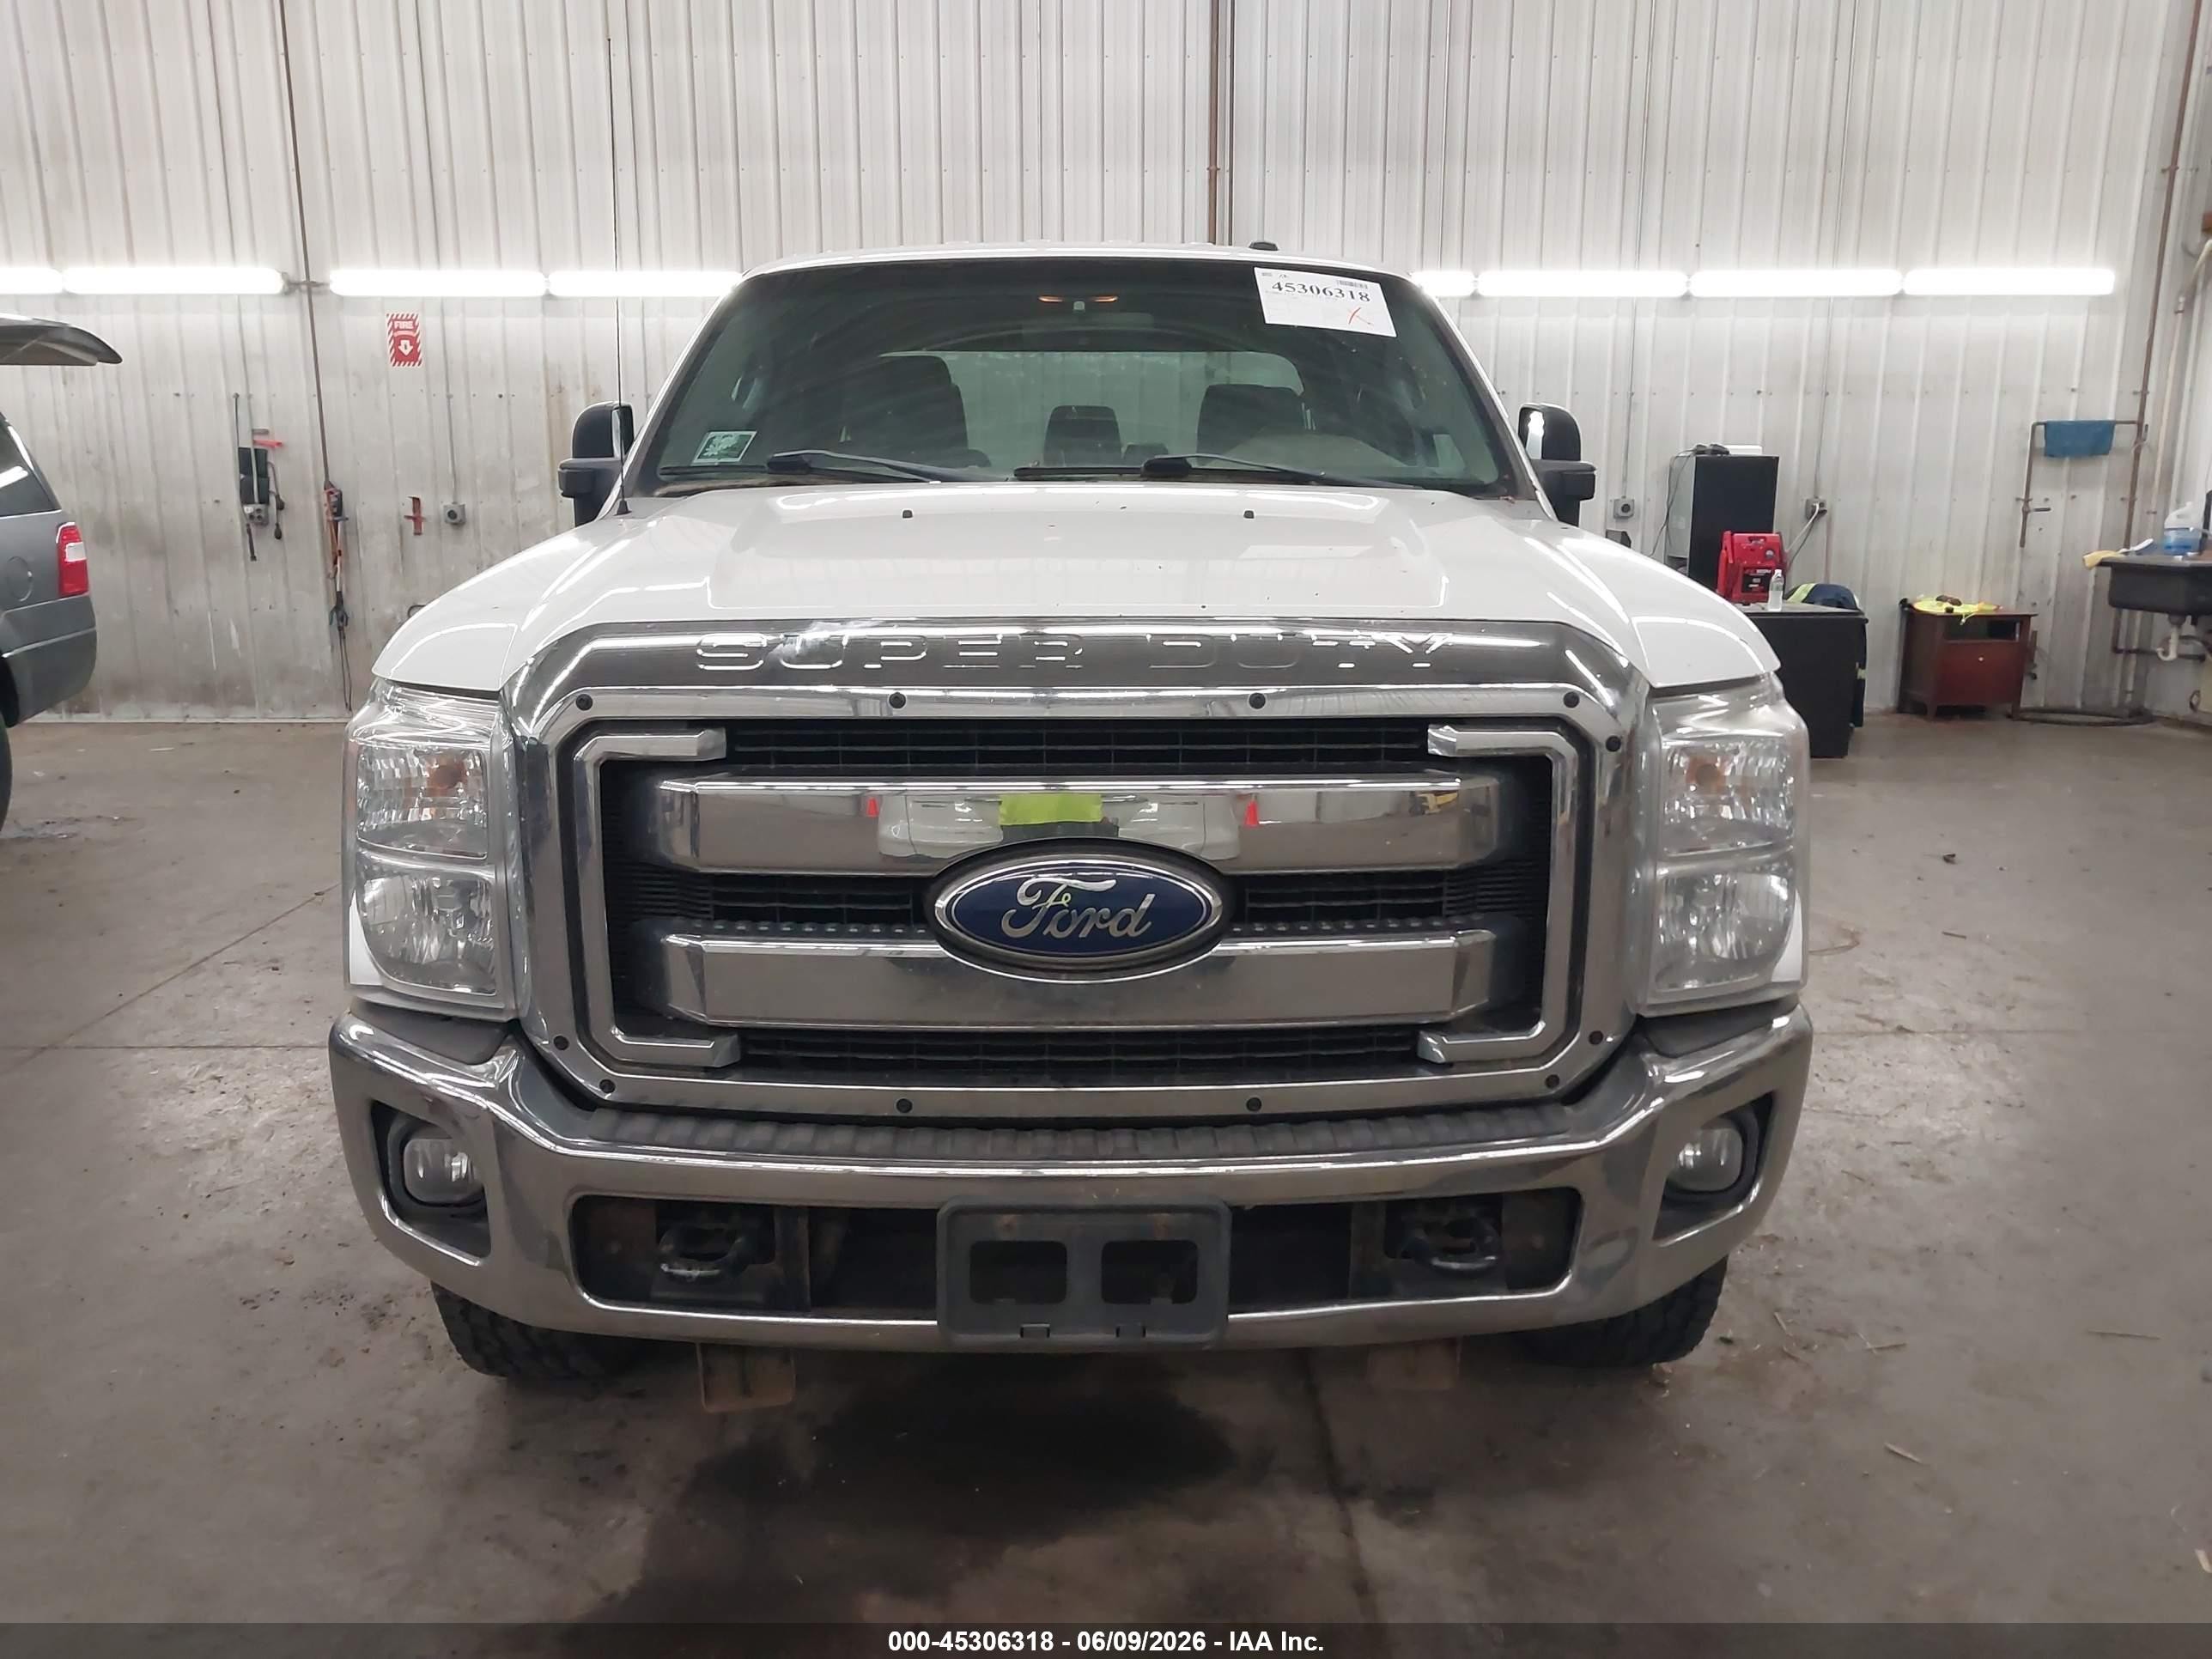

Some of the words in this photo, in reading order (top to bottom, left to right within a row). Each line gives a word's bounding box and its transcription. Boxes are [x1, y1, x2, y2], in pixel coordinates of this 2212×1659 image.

[1272, 281, 1371, 302] 45306318
[393, 320, 414, 330] FIRE
[696, 632, 1085, 671] SUPER
[1147, 631, 1455, 670] DUTY
[1001, 877, 1156, 939] Ford
